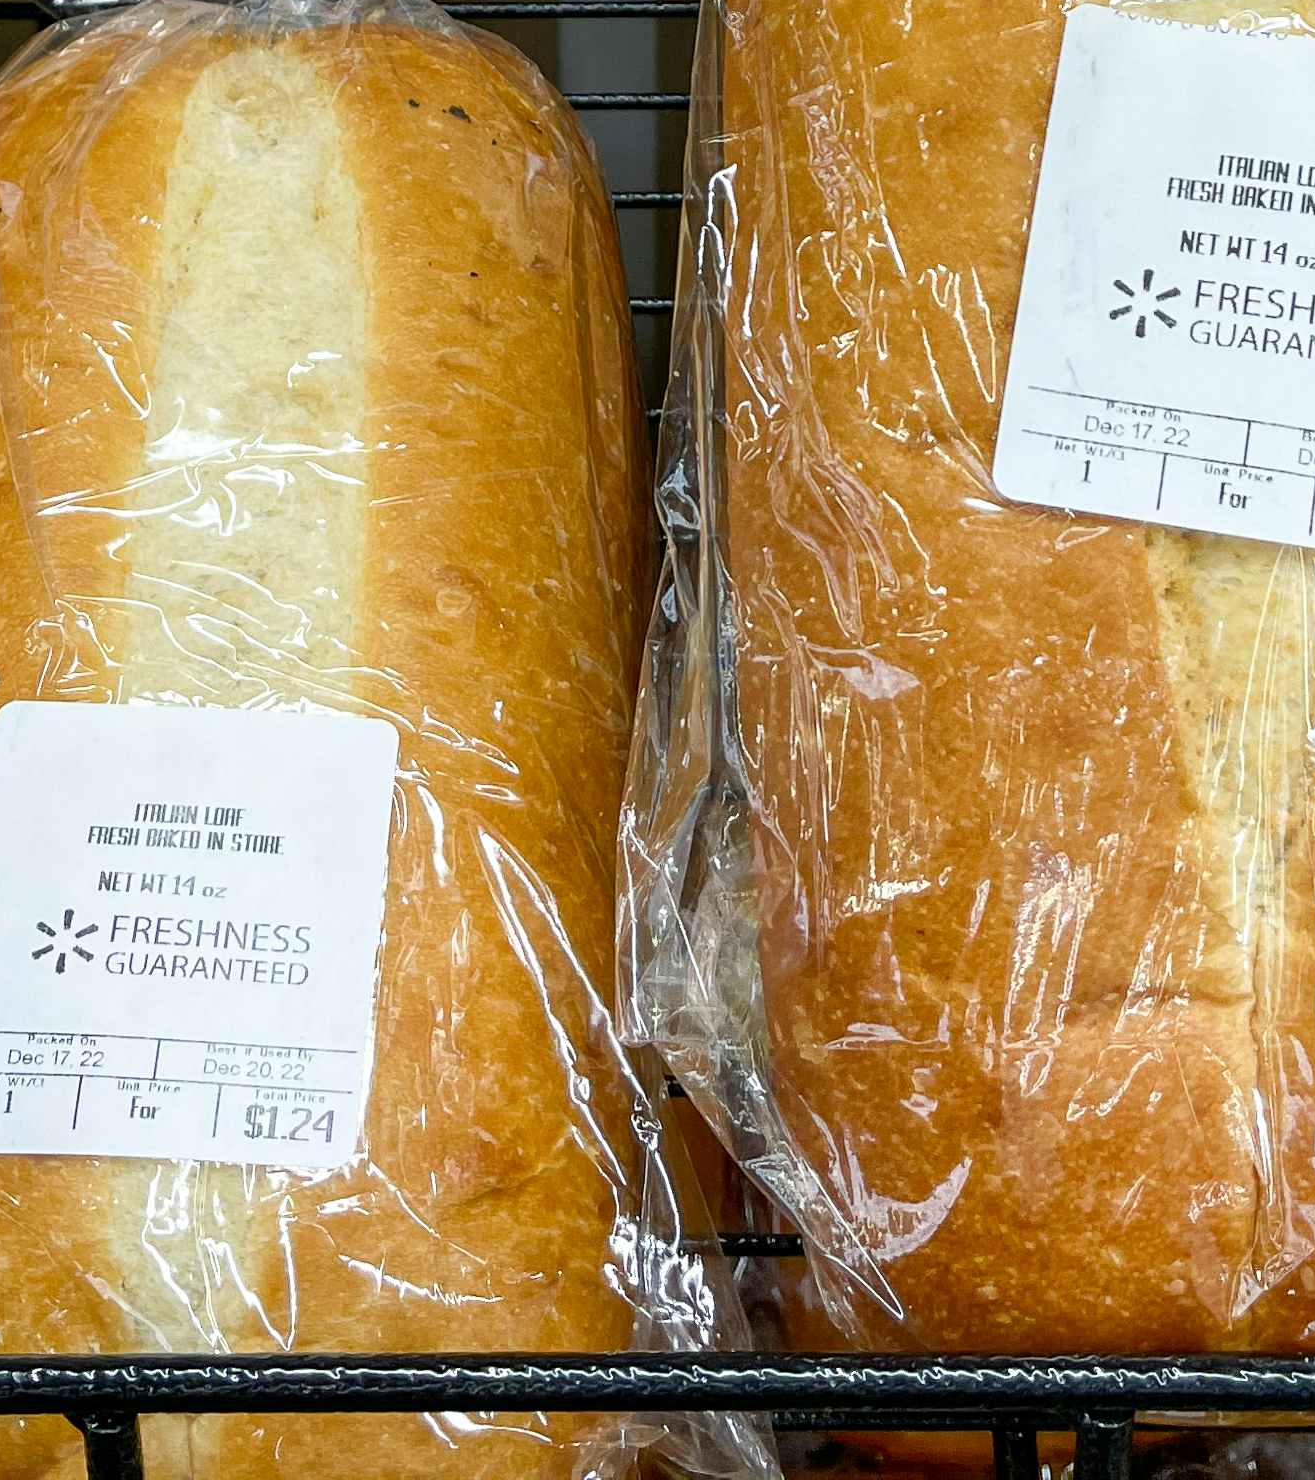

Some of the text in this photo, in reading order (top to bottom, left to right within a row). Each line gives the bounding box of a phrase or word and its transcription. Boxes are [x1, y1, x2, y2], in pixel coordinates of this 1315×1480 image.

[1218, 154, 1290, 184] ITALIAN
[1167, 177, 1224, 205] FRESH
[1231, 184, 1293, 213] BAKED
[1180, 229, 1220, 257] NET
[1226, 235, 1257, 261] WT
[1261, 240, 1289, 266] 14
[1106, 401, 1181, 423] Packed On
[1084, 414, 1125, 437] Dec
[1163, 427, 1191, 448] 22
[1054, 439, 1078, 454] Net
[1082, 459, 1092, 484] 1
[1204, 463, 1274, 484] Unit Price
[1217, 480, 1253, 510] For
[134, 803, 247, 828] ITALIAN LOAF
[87, 825, 287, 856] FRESH BAKED IN STORE
[97, 870, 229, 899] NET WT 14 oz
[109, 914, 312, 955] FRESHNESS
[105, 951, 310, 986] GUARANTEED
[27, 1034, 97, 1047] Packed On
[7, 1048, 45, 1066] Dec
[79, 1050, 106, 1069] 22
[202, 1058, 242, 1077] Dec
[281, 1063, 306, 1082] 22
[3, 1089, 14, 1115] 1
[129, 1094, 162, 1120] For
[254, 1088, 327, 1105] Total Price
[243, 1101, 336, 1144] $1.24
